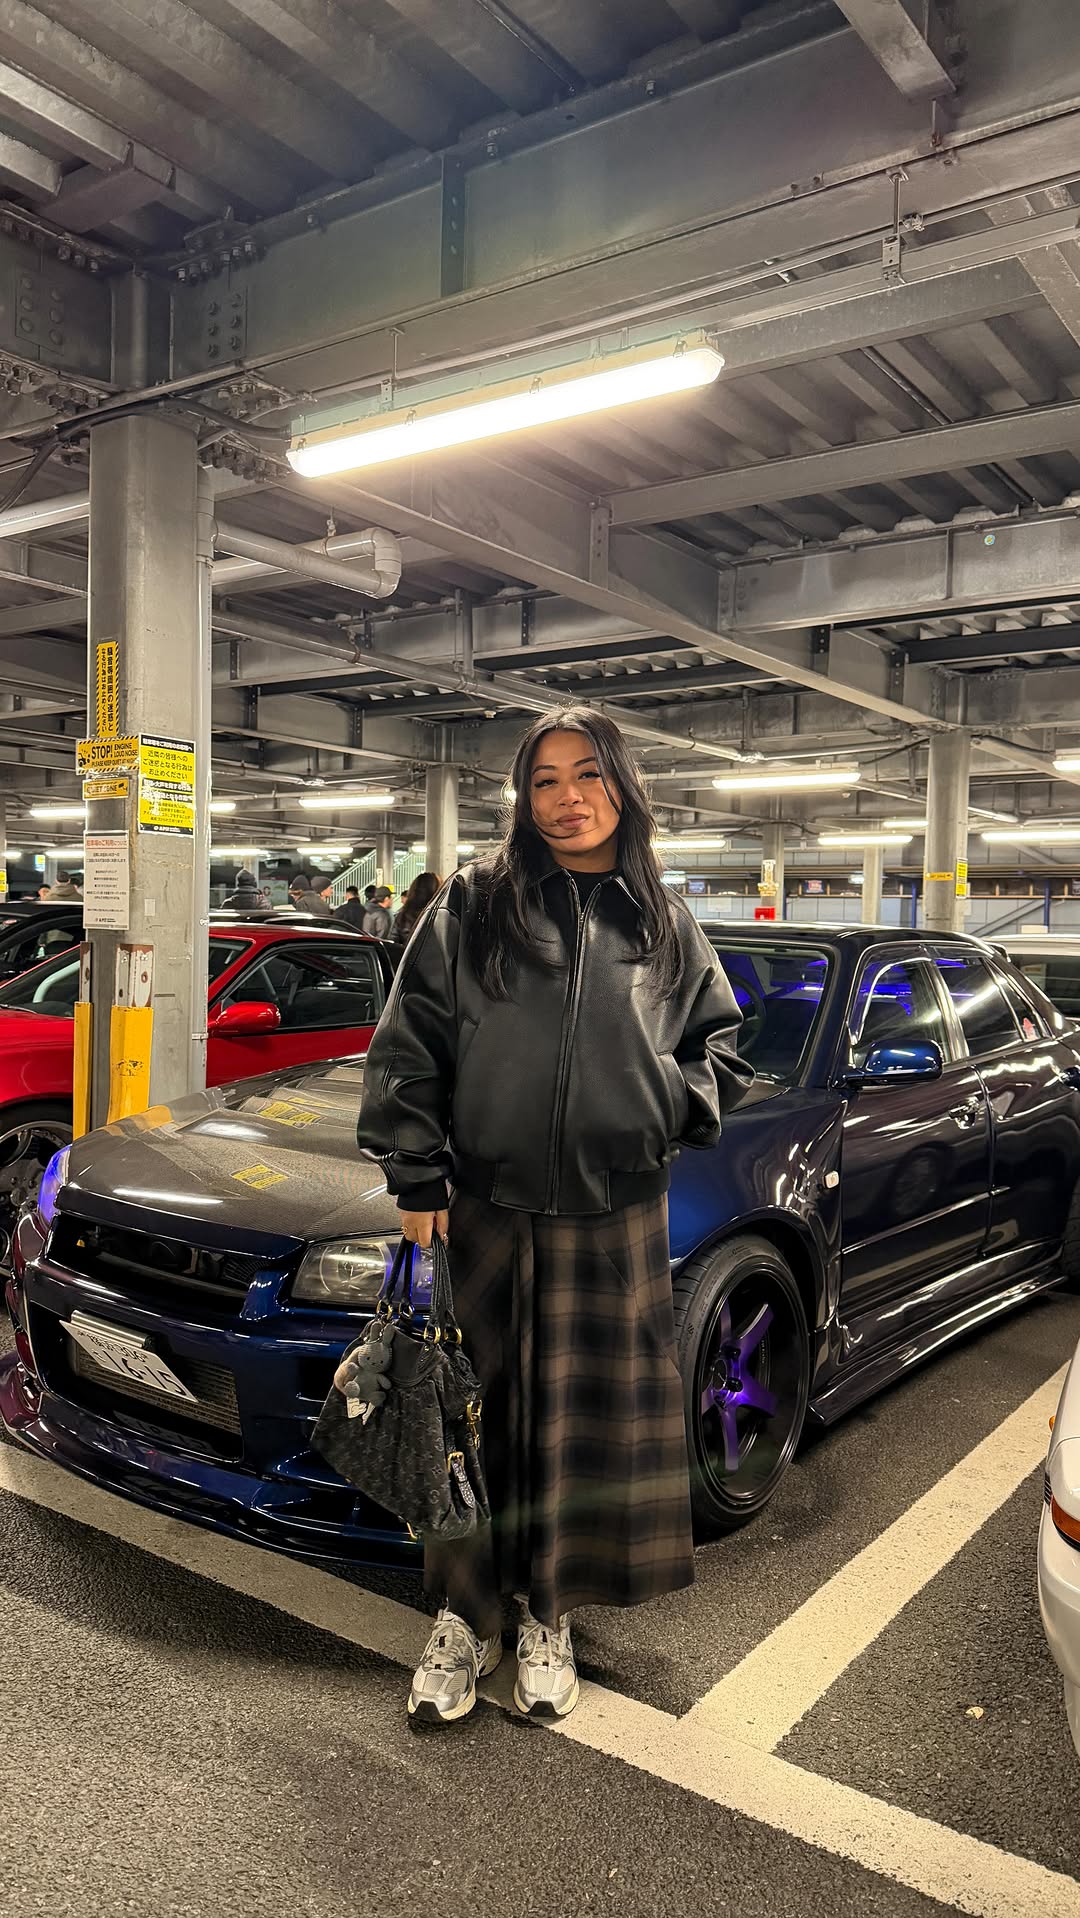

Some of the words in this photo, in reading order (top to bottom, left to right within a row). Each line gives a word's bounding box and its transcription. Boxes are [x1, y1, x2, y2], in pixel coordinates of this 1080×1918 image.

[91, 744, 113, 759] STOP!
[114, 742, 132, 751] ENGINE
[114, 750, 125, 758] LOUD
[125, 749, 138, 757] NOISE
[147, 750, 188, 762] 近隣の皆様への
[142, 758, 193, 772] ご迷惑となる行為は
[149, 768, 188, 780] お止めください
[103, 1350, 187, 1397] 16-15
